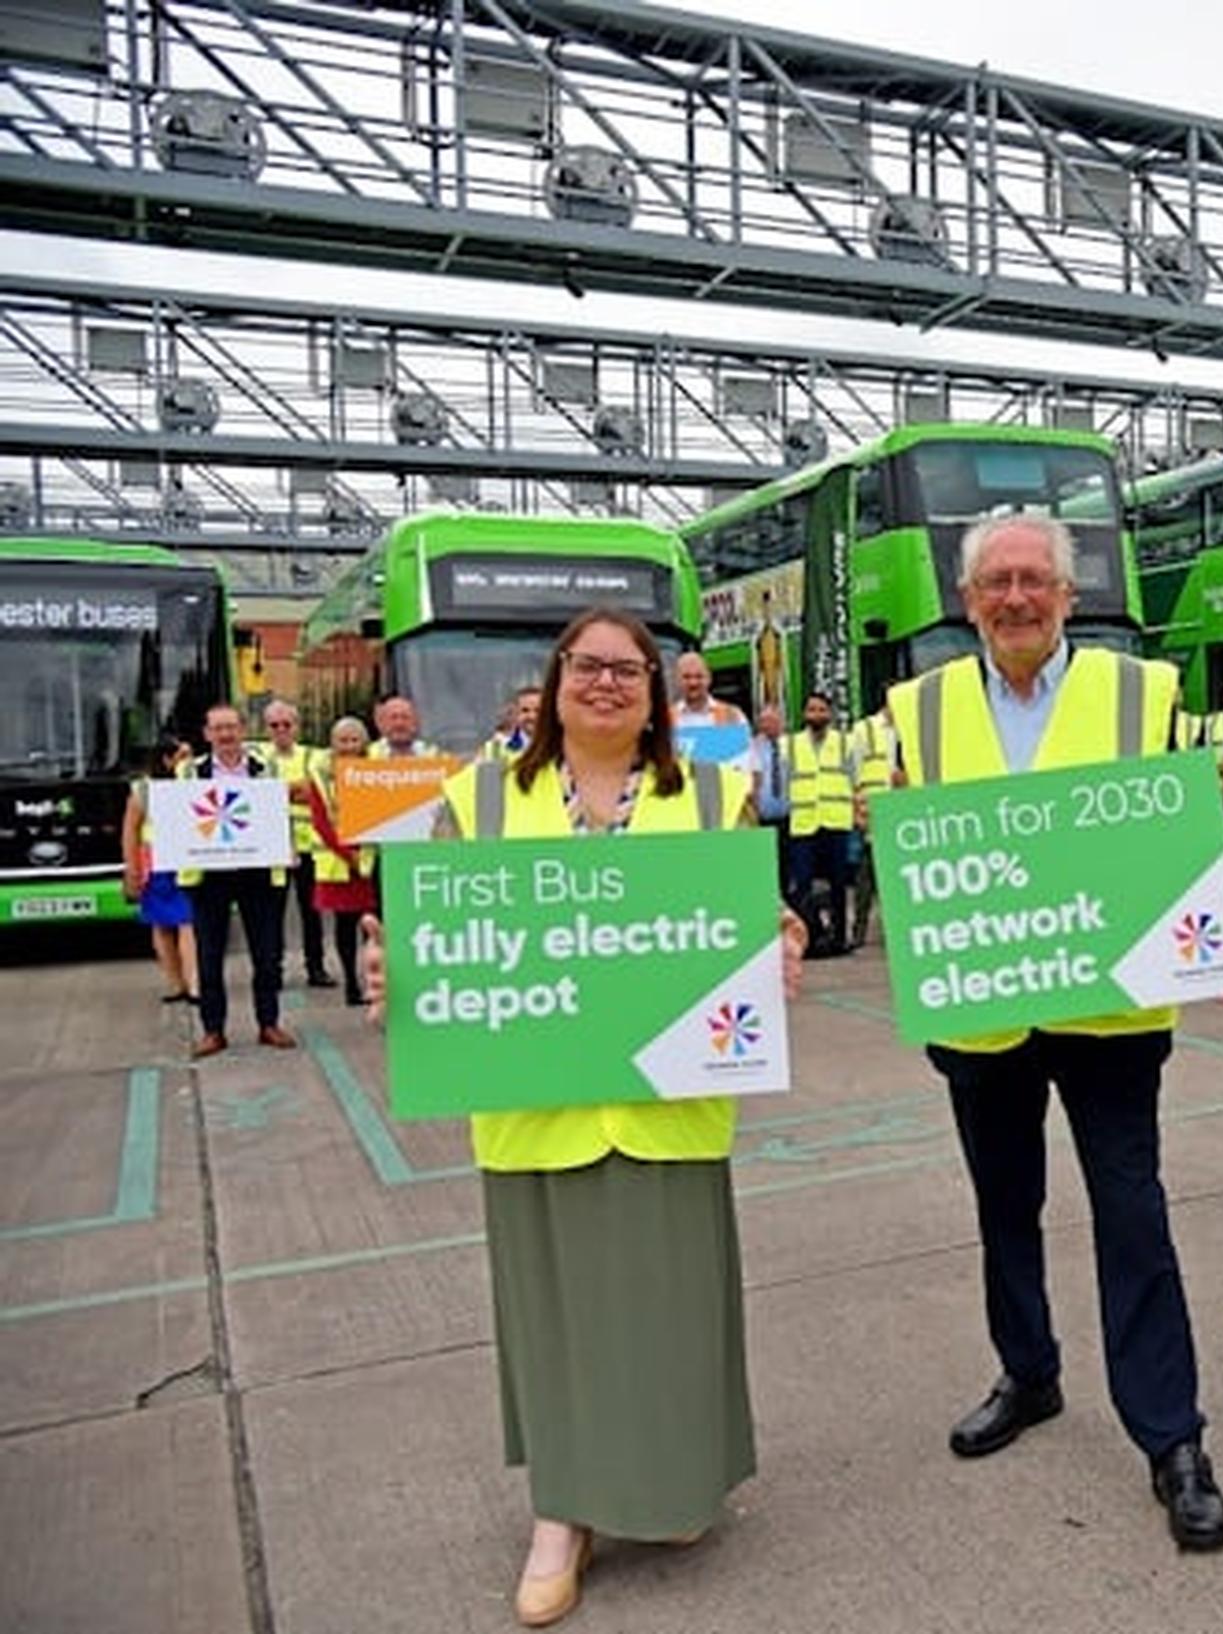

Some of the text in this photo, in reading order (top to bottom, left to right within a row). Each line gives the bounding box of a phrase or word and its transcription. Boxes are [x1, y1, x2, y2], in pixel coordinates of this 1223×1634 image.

[78, 598, 157, 629] buses
[345, 766, 447, 792] frequent
[896, 773, 1184, 851] aim for 2030
[412, 860, 625, 908] First Bus
[901, 851, 1030, 903] 100%
[412, 908, 739, 971] fully electric
[910, 891, 1106, 957] network
[415, 976, 579, 1031] depot
[918, 948, 1100, 1008] electric
